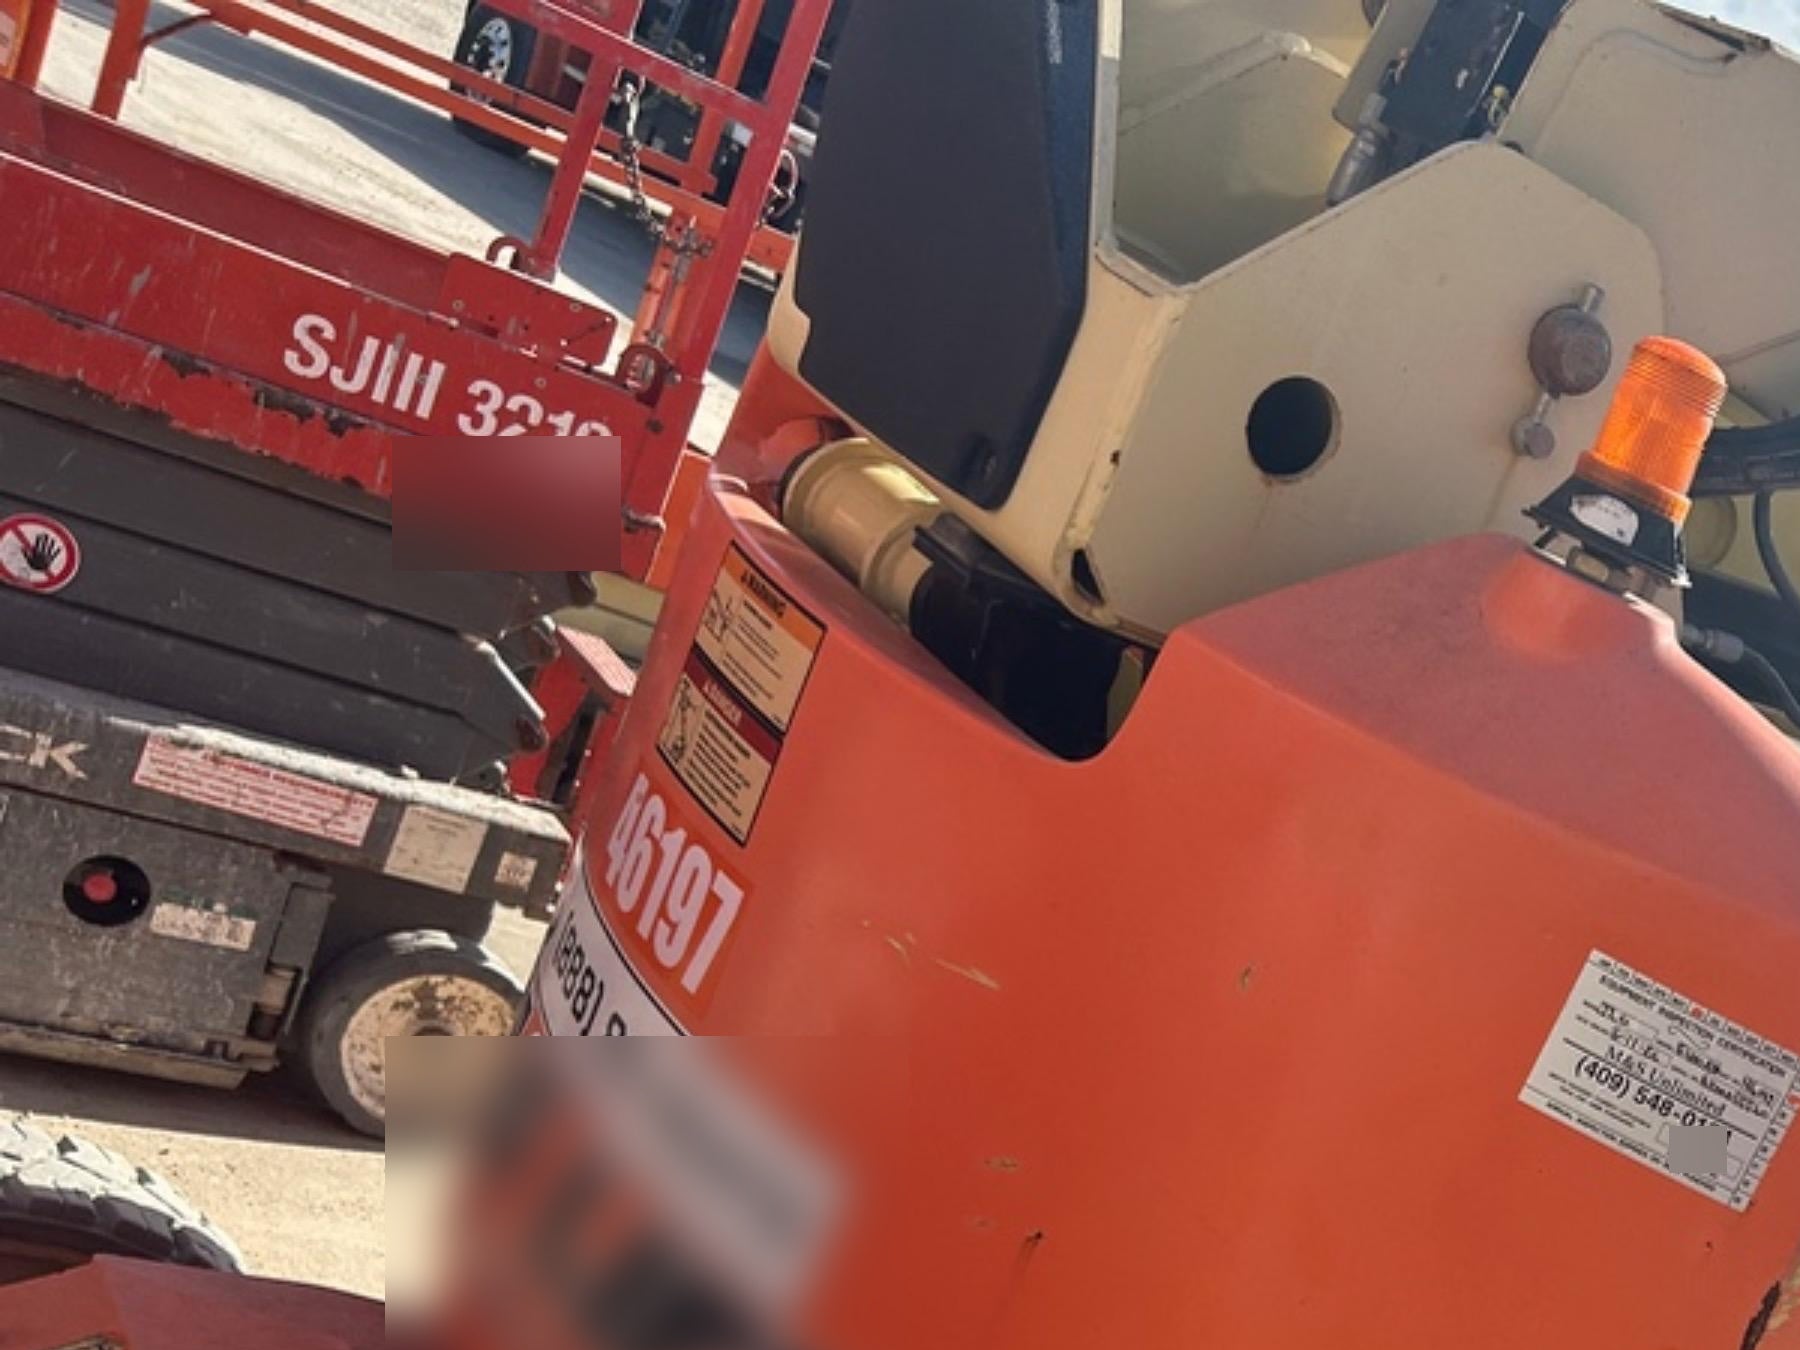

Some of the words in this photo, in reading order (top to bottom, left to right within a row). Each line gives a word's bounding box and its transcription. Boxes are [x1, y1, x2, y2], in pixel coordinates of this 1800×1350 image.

[284, 314, 446, 420] SJIII
[605, 773, 745, 995] 46197
[1572, 1054, 1632, 1099] (409)
